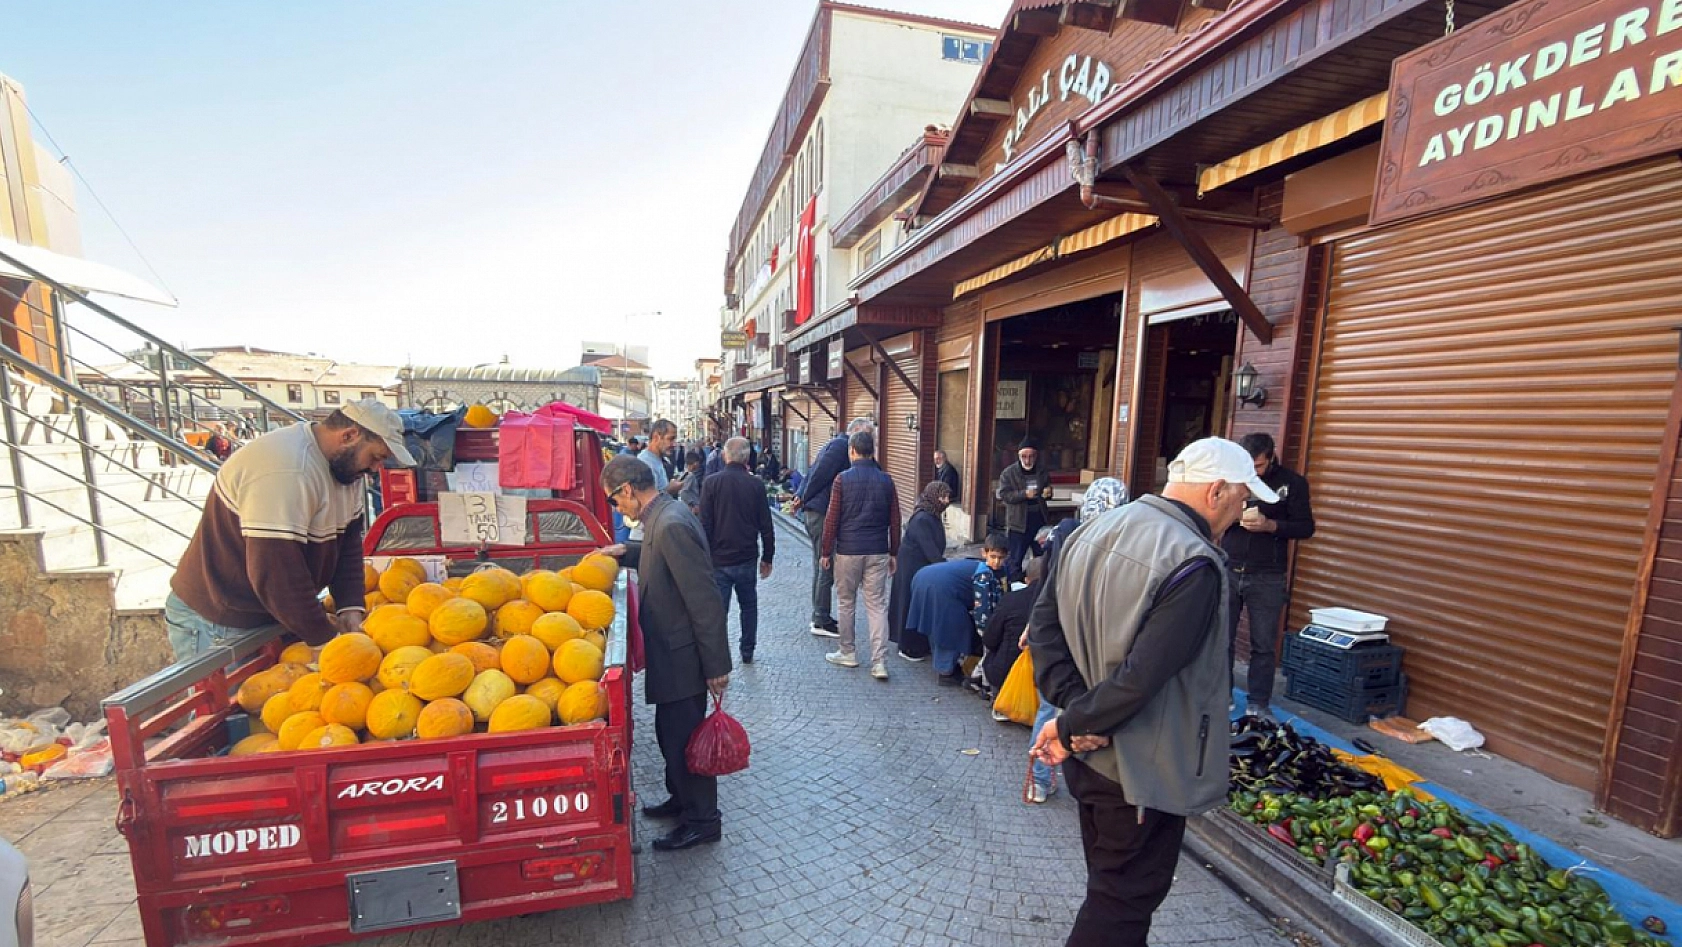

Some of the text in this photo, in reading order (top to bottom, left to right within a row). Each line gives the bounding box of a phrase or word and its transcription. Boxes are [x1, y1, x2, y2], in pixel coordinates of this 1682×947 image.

[994, 68, 1051, 174] PALI
[1418, 49, 1682, 167] AYDINLAR
[468, 514, 497, 524] TANE
[470, 494, 486, 515] 3
[477, 523, 498, 541] 50
[337, 775, 445, 800] ARORA
[492, 791, 590, 824] 21000
[184, 824, 301, 858] MOPED
